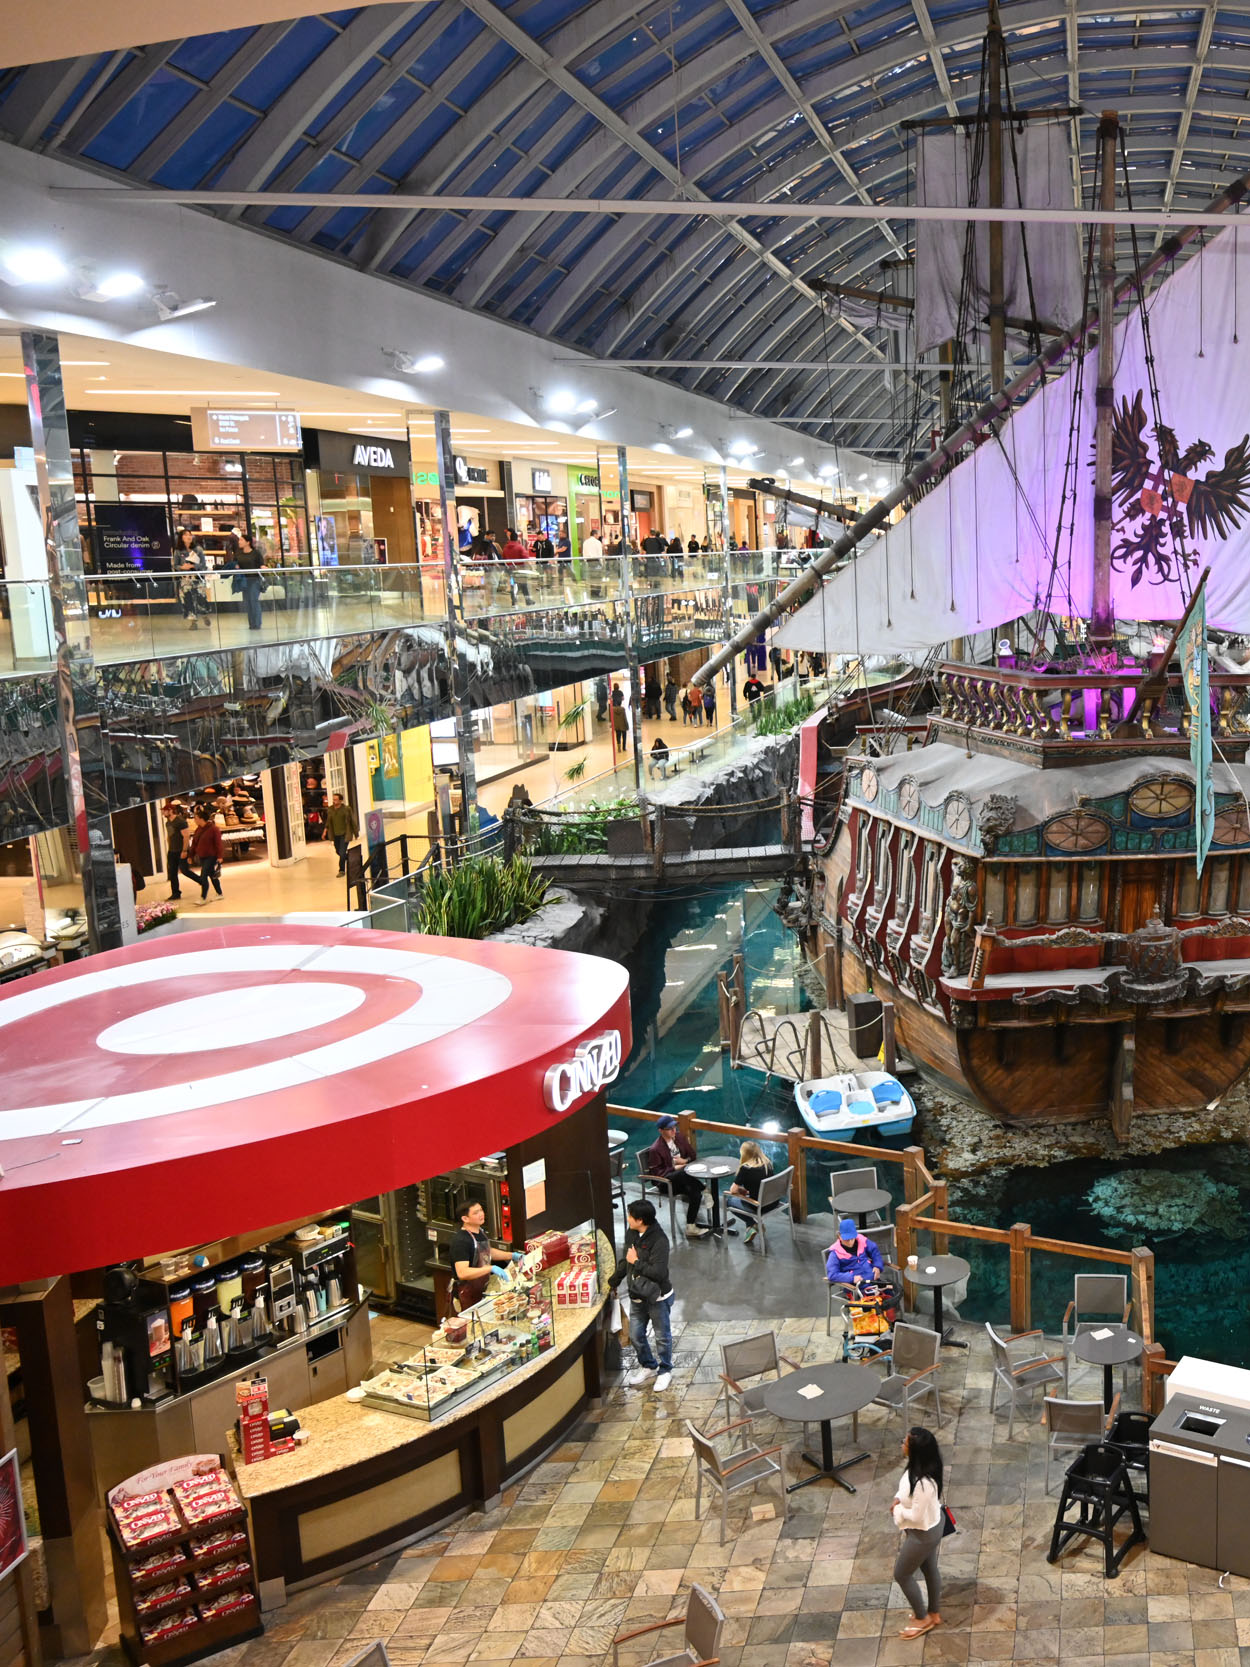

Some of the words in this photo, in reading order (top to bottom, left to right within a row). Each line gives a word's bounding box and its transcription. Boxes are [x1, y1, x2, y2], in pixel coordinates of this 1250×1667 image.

[353, 445, 394, 468] AVEDA
[546, 1029, 622, 1112] CINNZEO
[1199, 1405, 1221, 1414] WASTE
